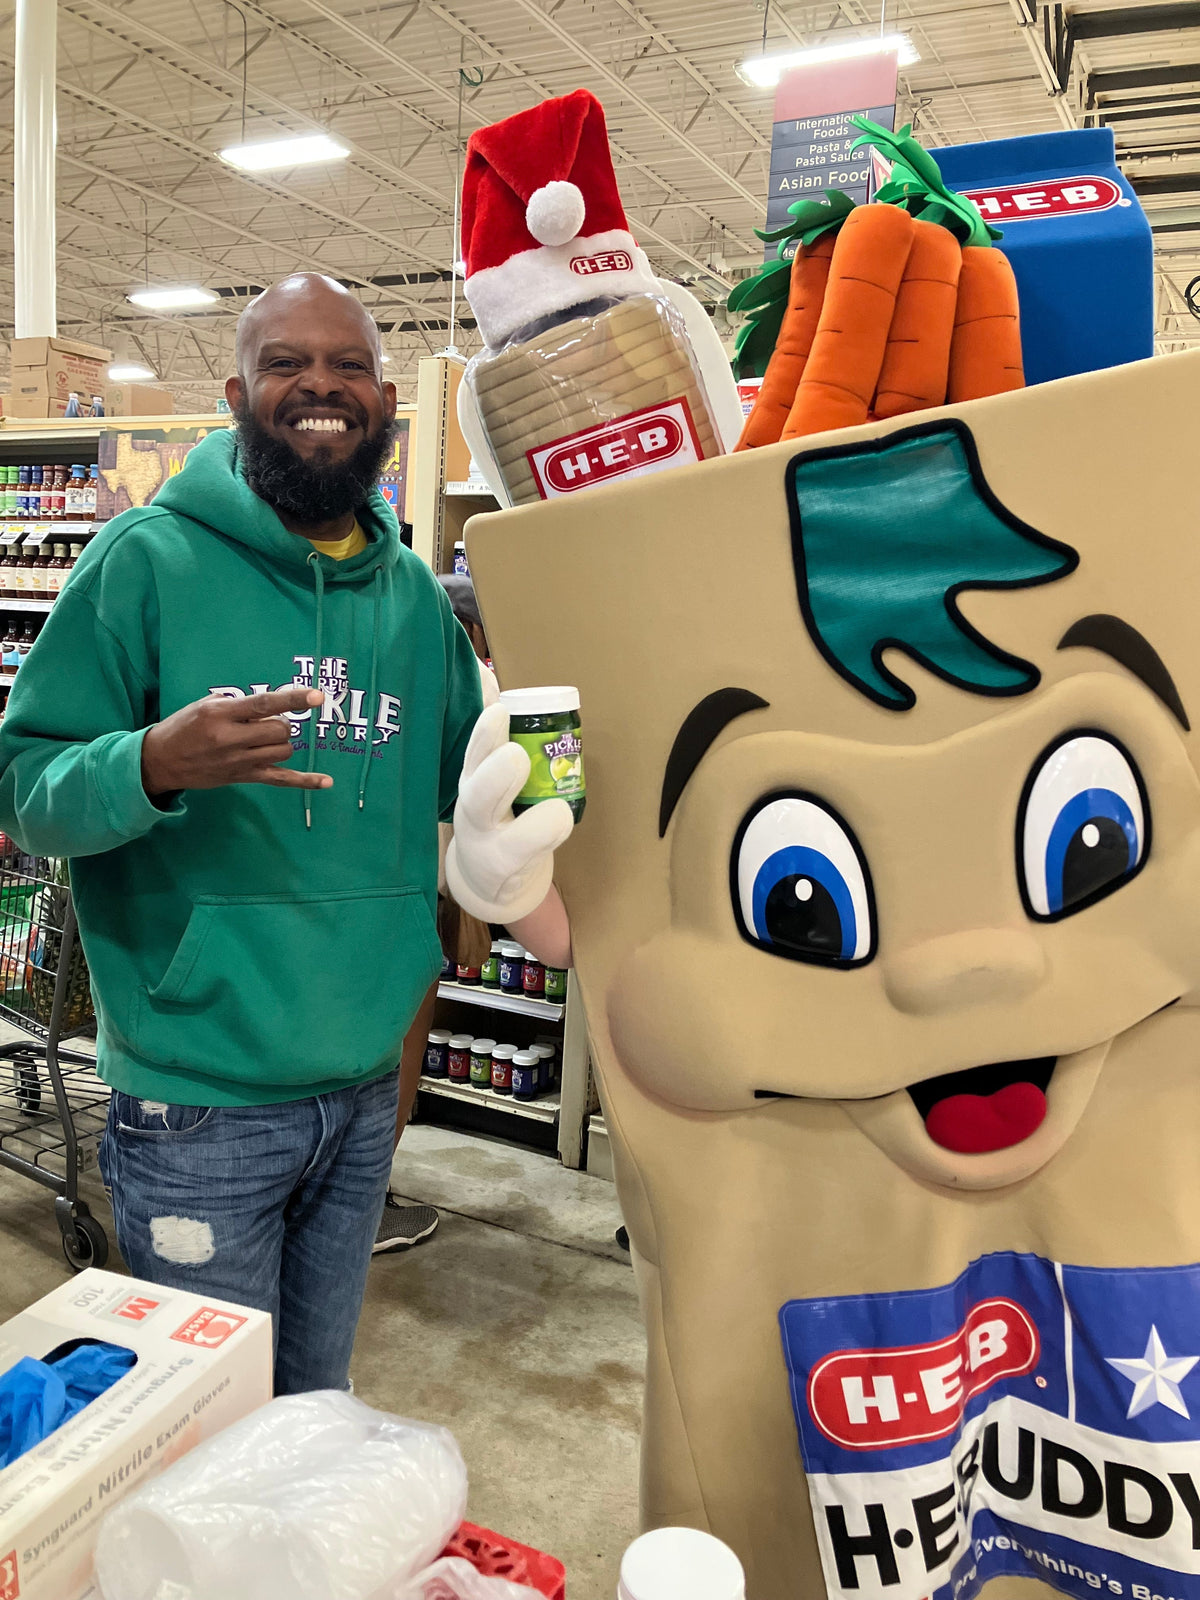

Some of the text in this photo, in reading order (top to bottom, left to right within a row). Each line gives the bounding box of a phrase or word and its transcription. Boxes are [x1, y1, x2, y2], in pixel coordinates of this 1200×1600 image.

[813, 126, 849, 139] Foods
[809, 140, 851, 154] Pasta &
[795, 150, 865, 168] Pasta Sauce
[779, 175, 822, 191] Asian
[293, 656, 348, 678] THE
[209, 683, 402, 732] CKLE
[289, 722, 395, 746] CTORY
[544, 738, 582, 754] PICKLE
[73, 1288, 104, 1308] 100
[117, 1297, 160, 1321] M
[48, 1416, 127, 1472] Nitrile
[23, 1497, 92, 1564] Synguard
[98, 1444, 153, 1499] Nitrile
[156, 1413, 190, 1449] Exam
[193, 1376, 231, 1414] Gloves
[974, 1533, 1123, 1596] Everything's
